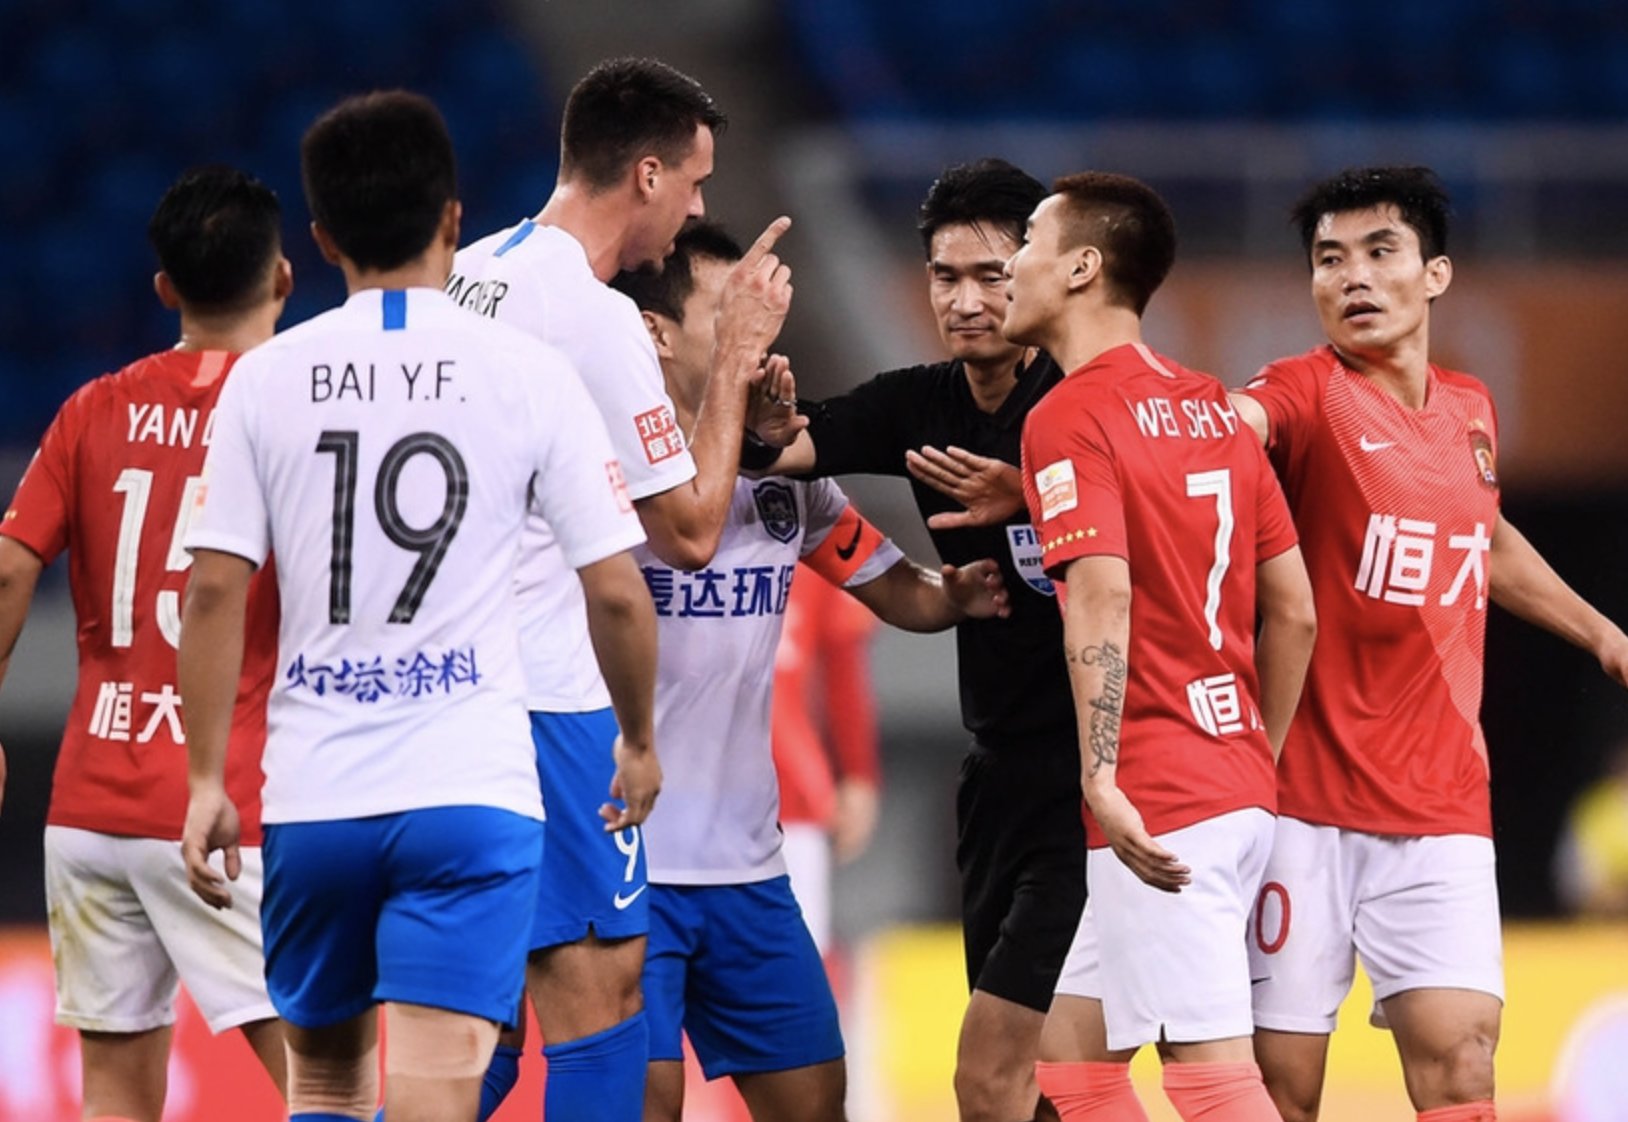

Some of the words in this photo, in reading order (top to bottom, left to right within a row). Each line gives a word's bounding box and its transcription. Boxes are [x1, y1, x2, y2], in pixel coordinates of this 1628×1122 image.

[311, 363, 375, 402] BAI
[401, 361, 466, 402] Y.F.
[315, 430, 469, 624] 19
[1012, 528, 1041, 546] FI
[1186, 469, 1234, 650] 7
[1354, 513, 1491, 610] 恒大
[284, 648, 481, 703] 灯塔涂料
[1185, 672, 1265, 737] 恒
[88, 681, 186, 744] 恒大
[614, 825, 639, 882] 9
[1255, 881, 1291, 955] 0
